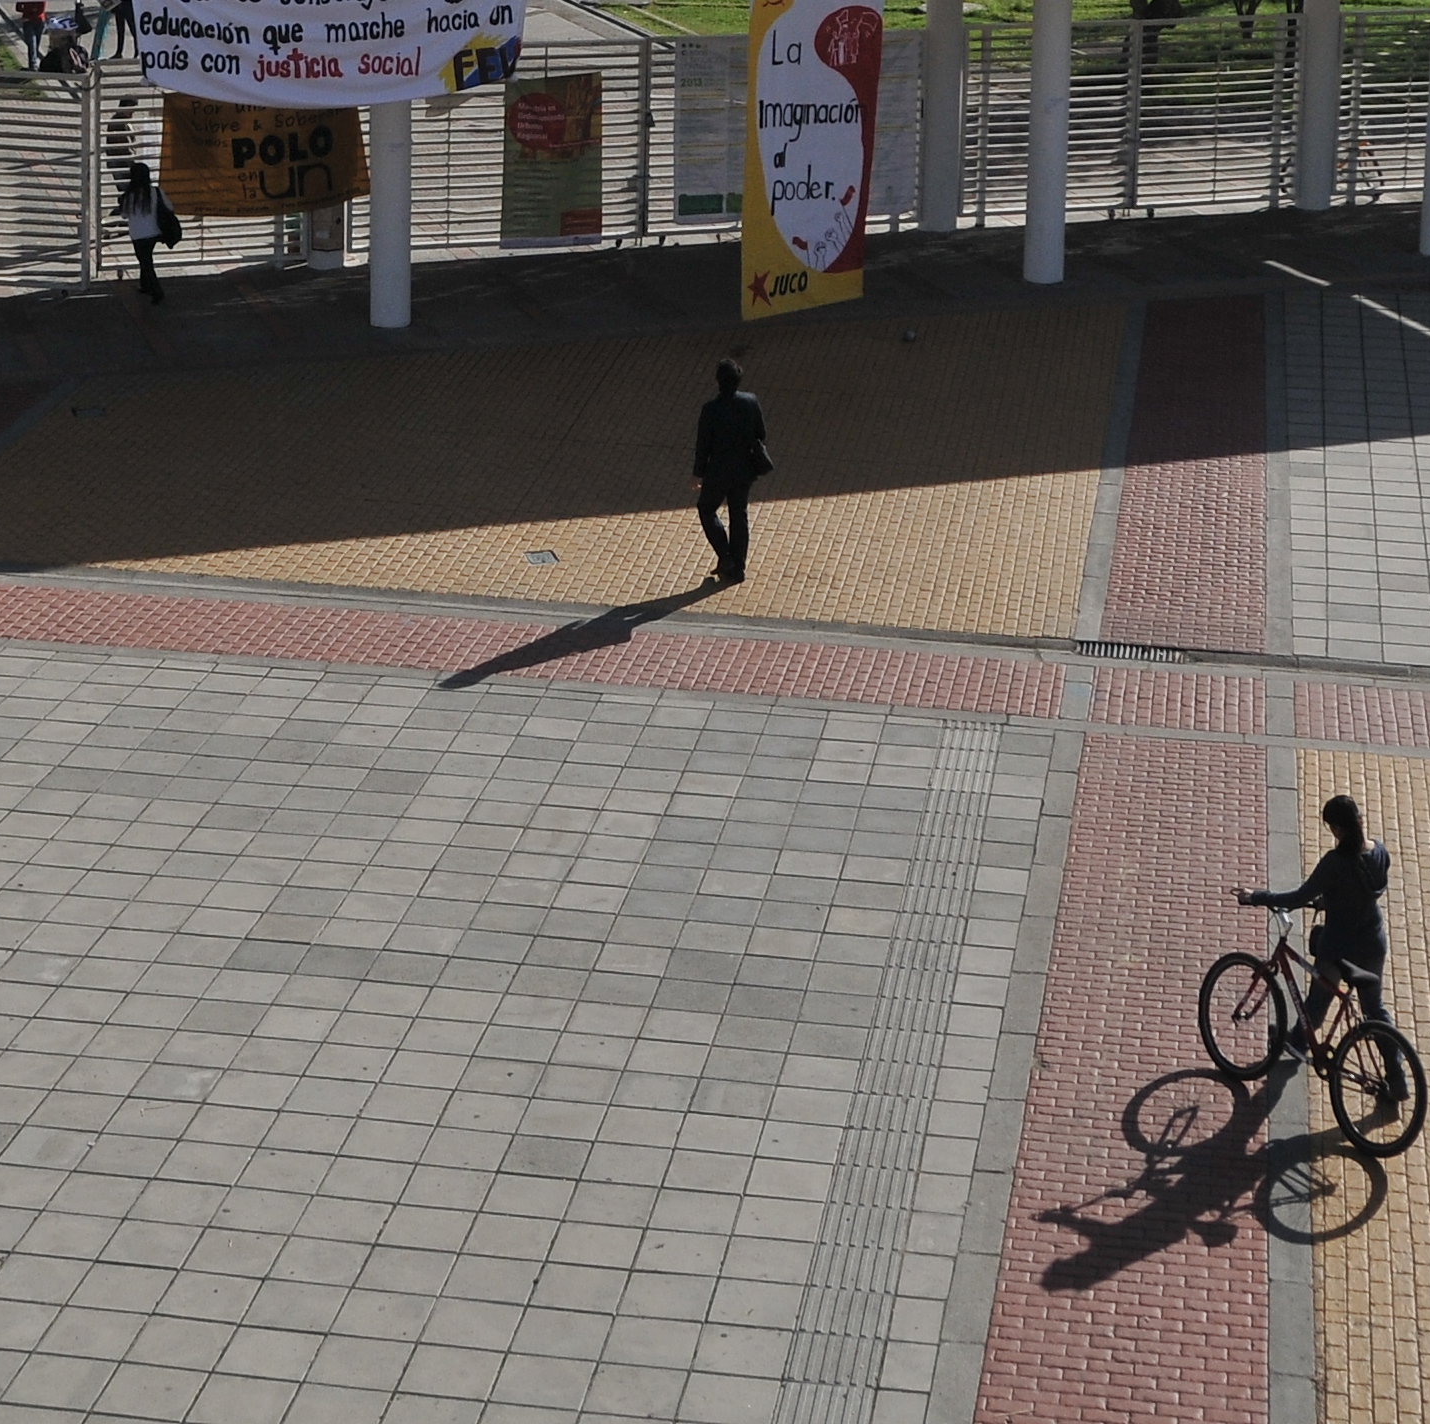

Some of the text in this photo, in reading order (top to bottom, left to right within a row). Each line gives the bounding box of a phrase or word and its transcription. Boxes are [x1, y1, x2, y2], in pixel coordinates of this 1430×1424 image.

[139, 4, 513, 55] educación que marche hacia un
[771, 30, 802, 66] La
[141, 45, 421, 82] país con justicia social
[681, 78, 703, 88] 2013
[191, 100, 222, 115] Por
[231, 126, 334, 169] POLO
[774, 143, 788, 169] al
[237, 171, 259, 182] en
[243, 183, 257, 200] la
[771, 164, 836, 217] poder.
[769, 271, 808, 298] JUCO
